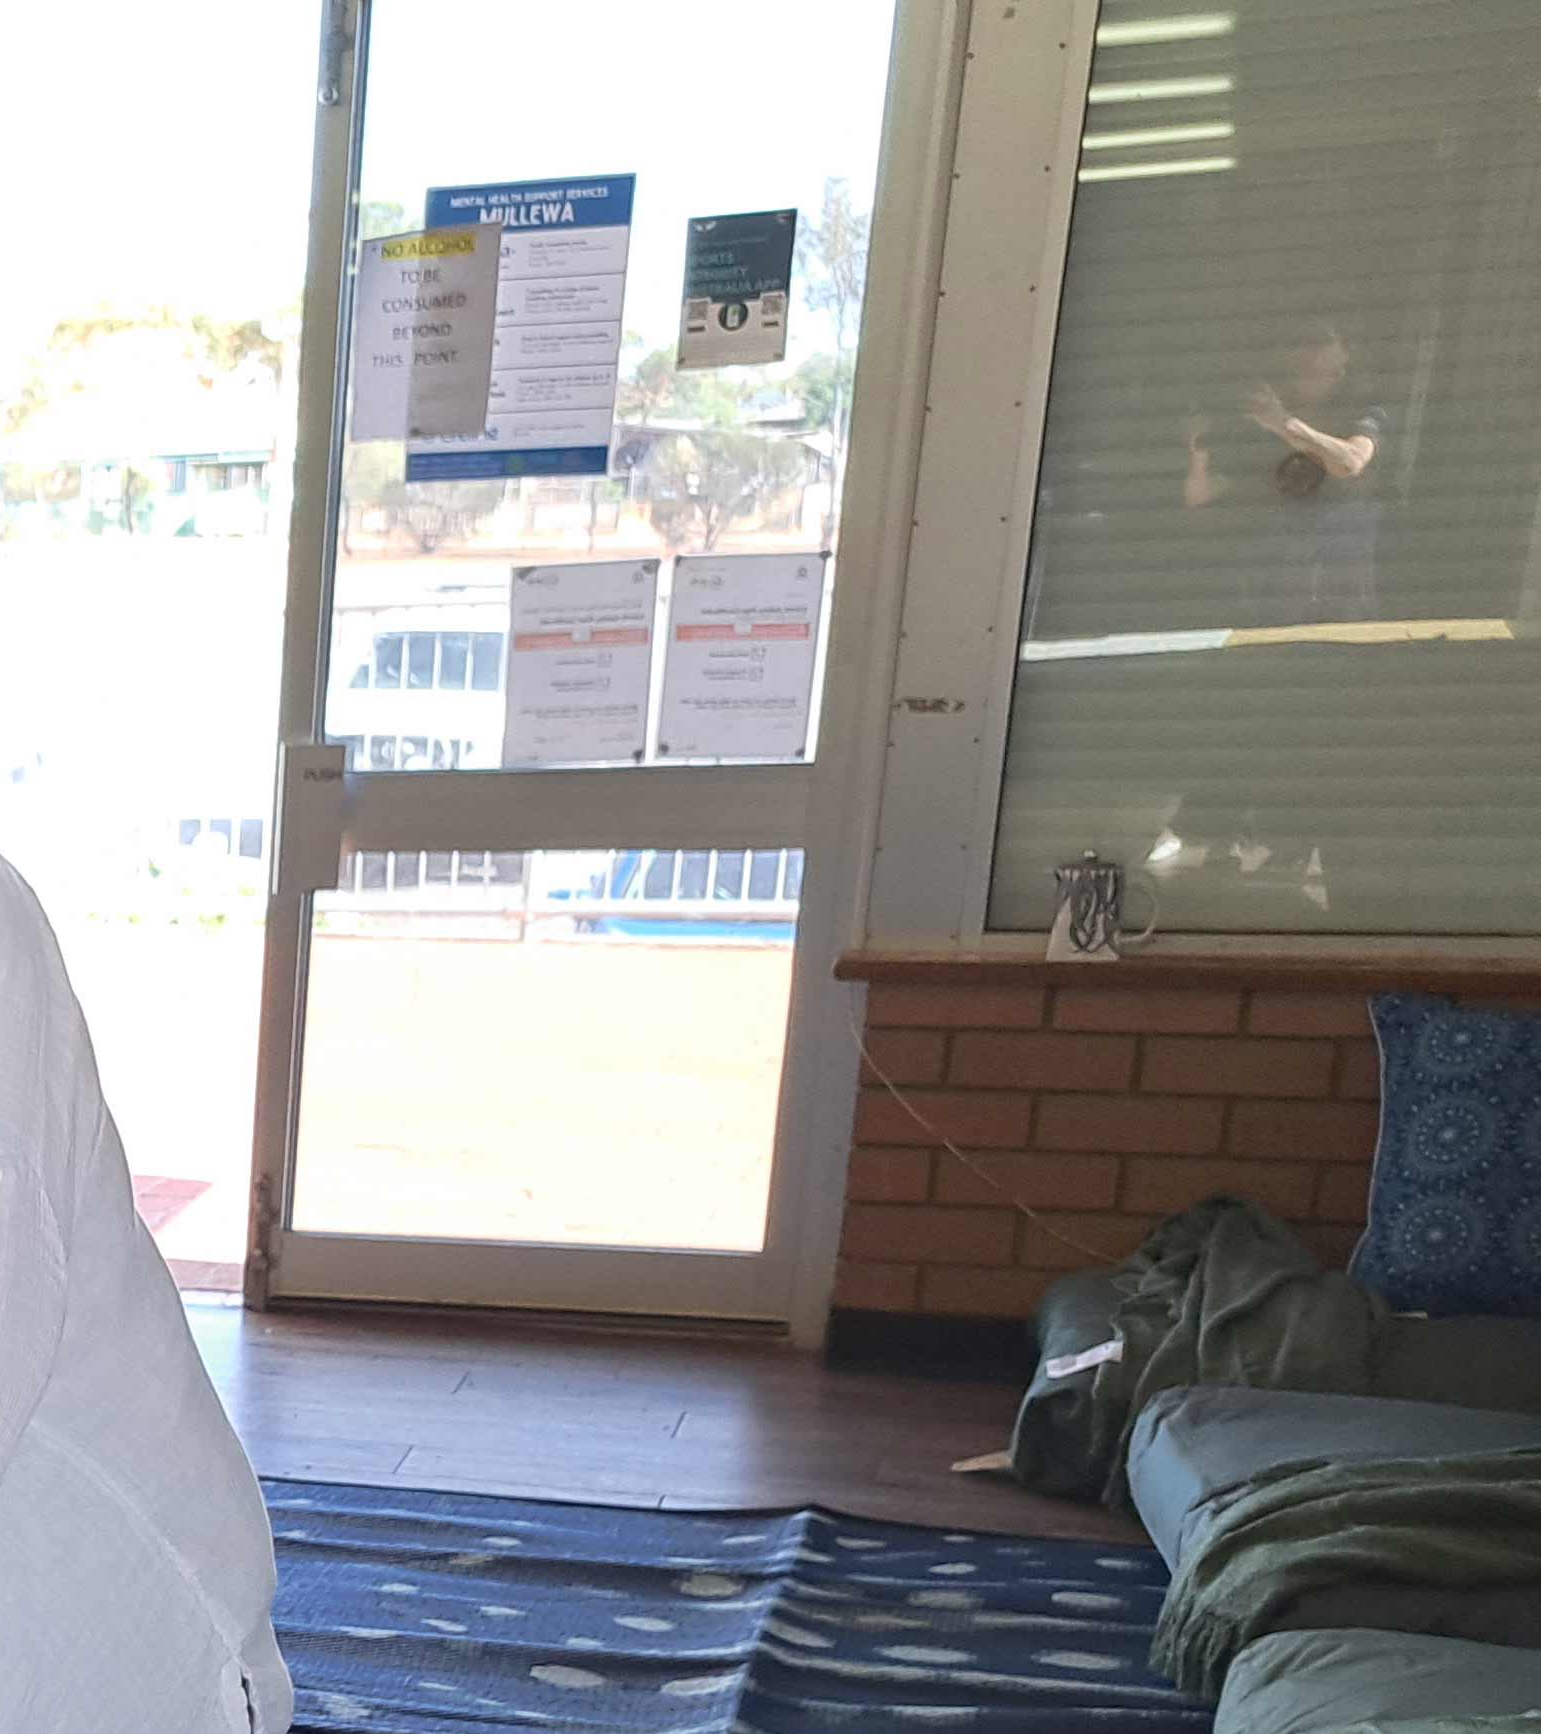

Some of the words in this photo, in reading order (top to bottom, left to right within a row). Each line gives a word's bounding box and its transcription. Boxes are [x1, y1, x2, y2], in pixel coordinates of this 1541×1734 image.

[479, 202, 575, 227] MULLEWA
[380, 243, 404, 258] NO
[408, 238, 475, 256] ALCOHOL
[400, 270, 419, 284] TO
[422, 269, 442, 283] BE
[381, 292, 467, 314] CONSUMED
[392, 321, 454, 340] BEYOND
[372, 353, 404, 368] THIS
